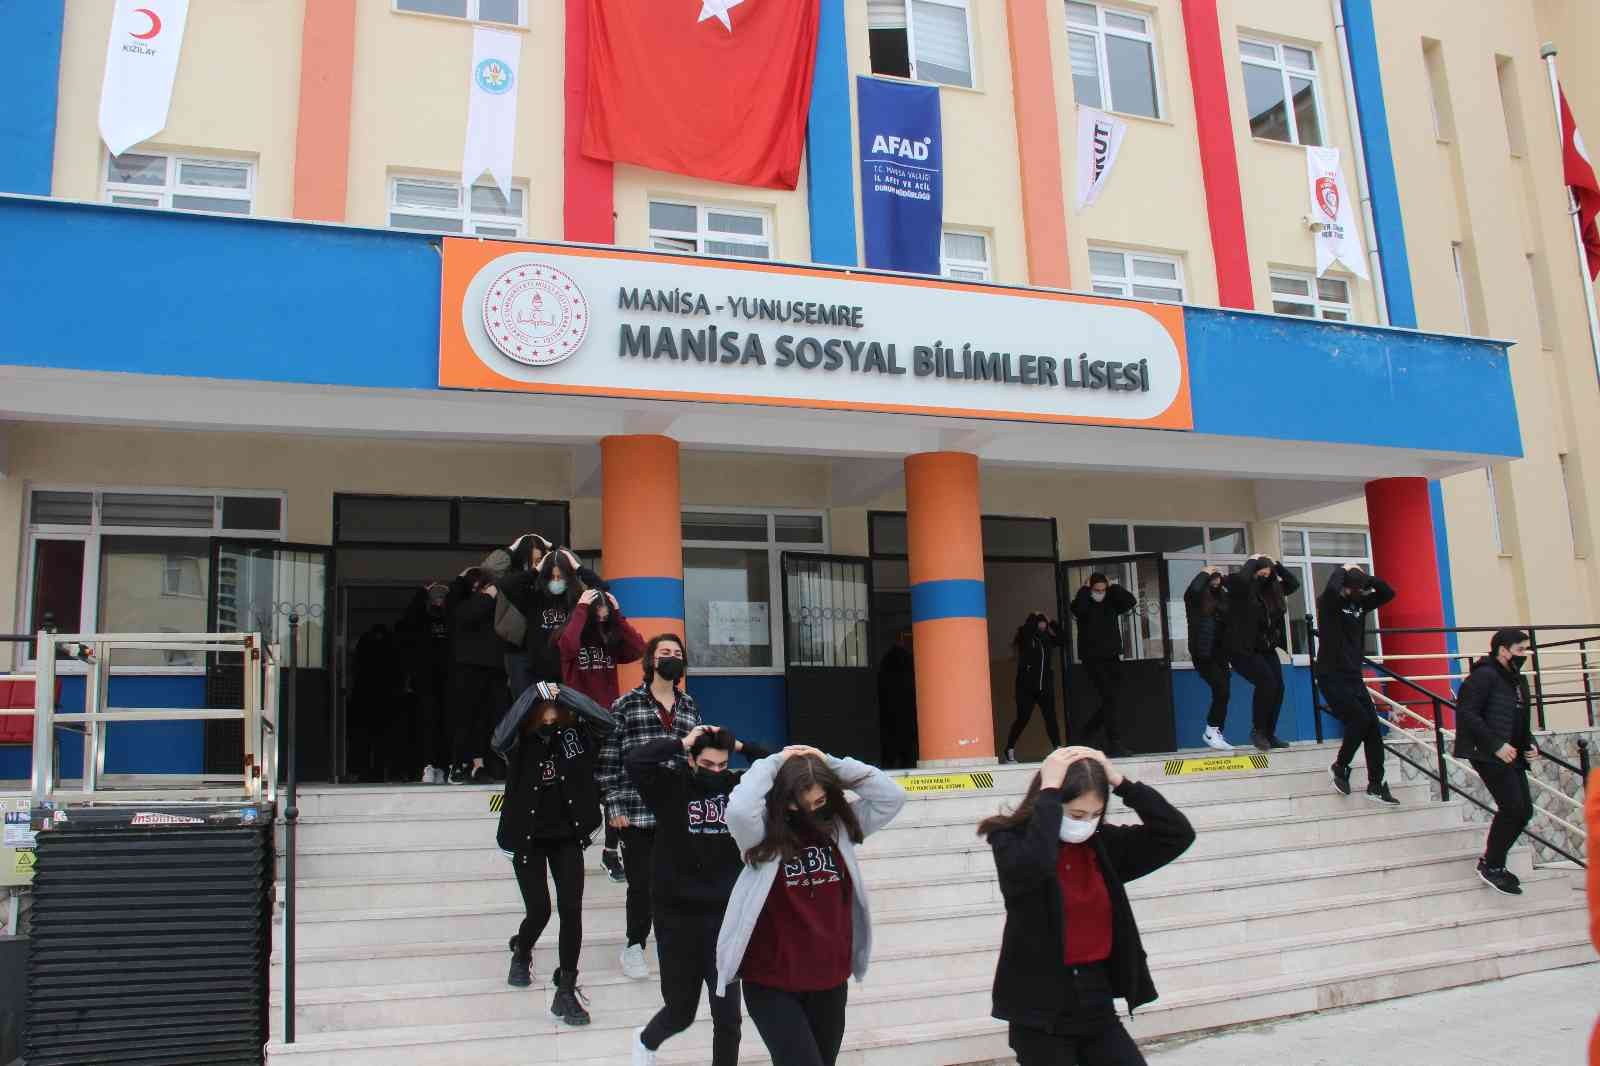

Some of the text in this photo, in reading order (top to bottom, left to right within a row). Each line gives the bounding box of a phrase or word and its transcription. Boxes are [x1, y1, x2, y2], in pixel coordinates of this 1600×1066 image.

[121, 44, 156, 57] KIZILAY
[872, 135, 930, 160] AFAD
[618, 286, 710, 316] MANİSA
[618, 323, 1150, 392] MANİSA SOSYAL BİLİMLER LİSESİ
[563, 727, 585, 759] R
